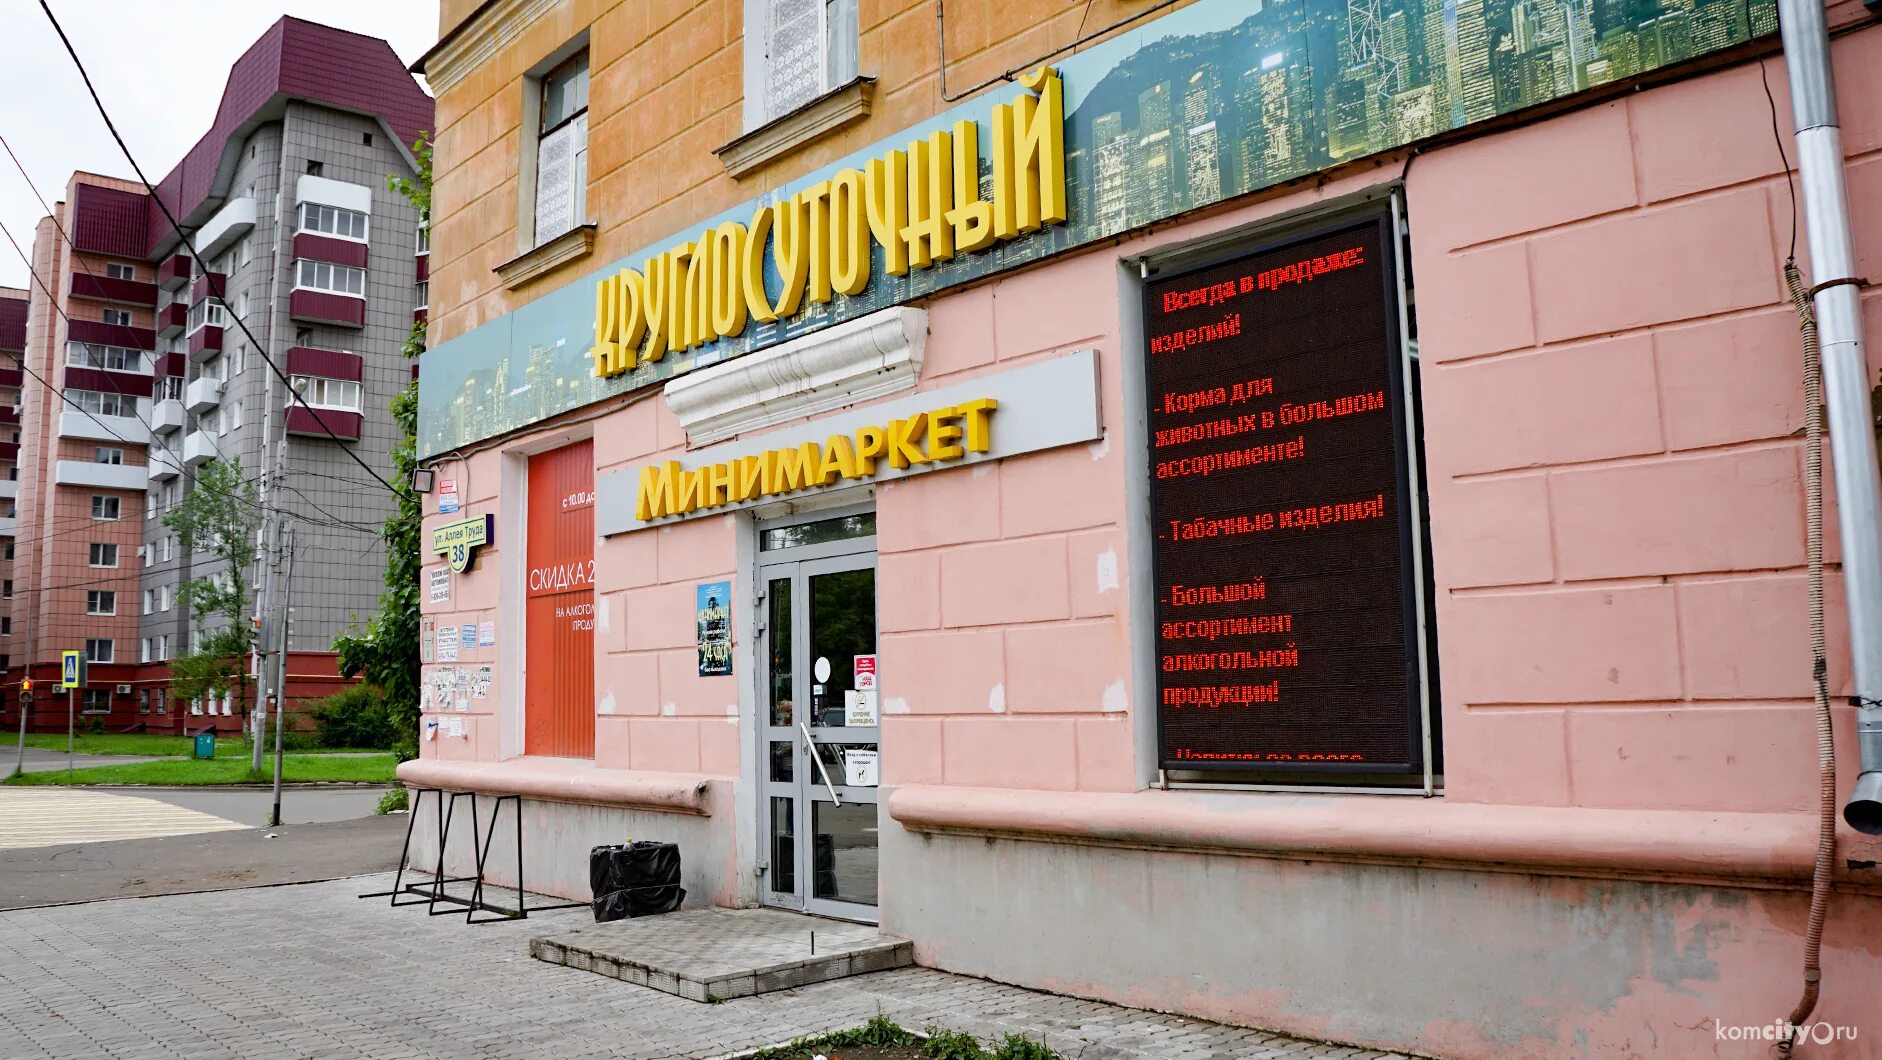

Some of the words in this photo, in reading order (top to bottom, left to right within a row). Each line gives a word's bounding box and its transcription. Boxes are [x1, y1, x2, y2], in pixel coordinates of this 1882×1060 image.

[591, 66, 1067, 378] КРУГЛОСУТОЧНЫЙ
[1163, 279, 1236, 313] Всегда
[1240, 275, 1254, 294] в
[1258, 246, 1364, 291] продаже:
[1151, 313, 1241, 354] изделий!
[1164, 386, 1226, 415] Корма
[1230, 376, 1273, 404] для
[1155, 413, 1256, 448] животных
[1262, 410, 1275, 430] в
[1280, 391, 1384, 425] большом
[1156, 436, 1304, 479] ассортименте!
[569, 492, 585, 507] 10.00
[1170, 511, 1274, 541] Табачные
[1280, 494, 1384, 530] изделия!
[434, 535, 443, 548] ул.
[445, 530, 463, 542] Аллея
[465, 524, 483, 539] Труда
[452, 543, 465, 563] 38
[530, 560, 585, 591] СКИДКА
[1172, 575, 1266, 606] Большой
[556, 607, 565, 618] НА
[1161, 614, 1292, 641] ассортимент
[1163, 642, 1298, 672] алкогольной
[1163, 680, 1279, 708] продукции!
